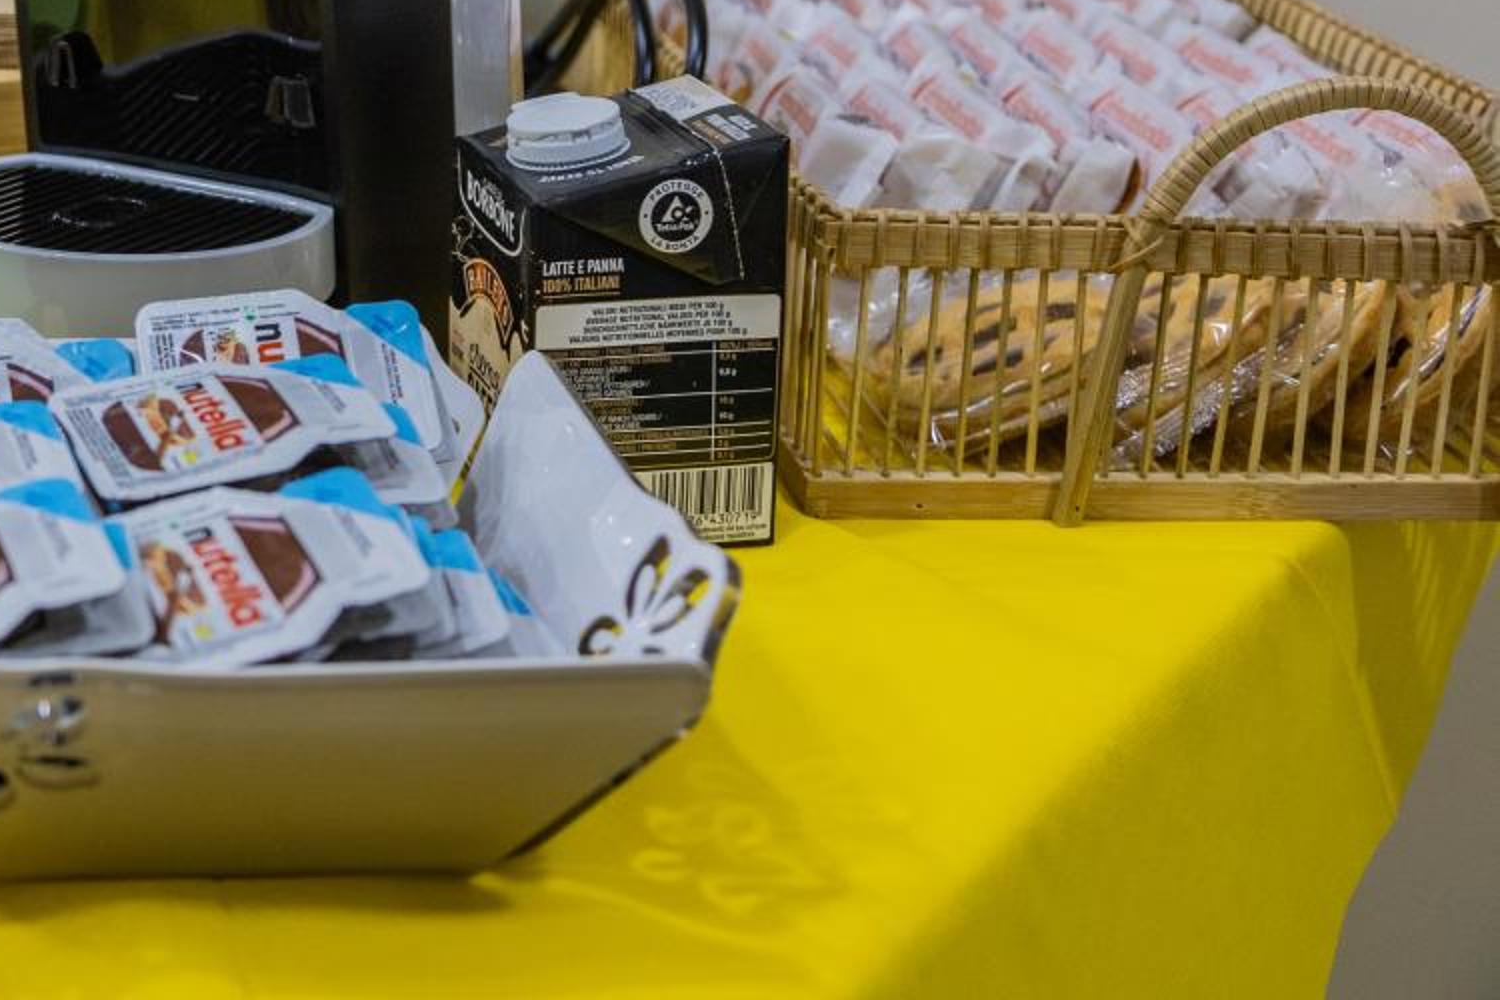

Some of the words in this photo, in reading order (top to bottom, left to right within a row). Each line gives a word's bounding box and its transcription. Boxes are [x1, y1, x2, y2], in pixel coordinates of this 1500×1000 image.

[467, 170, 516, 243] BORBONE
[542, 278, 572, 293] 100%
[543, 261, 576, 276] LATTE
[577, 259, 585, 274] E
[587, 258, 625, 273] PANNA
[175, 381, 247, 451] nutella
[183, 525, 263, 627] nutella
